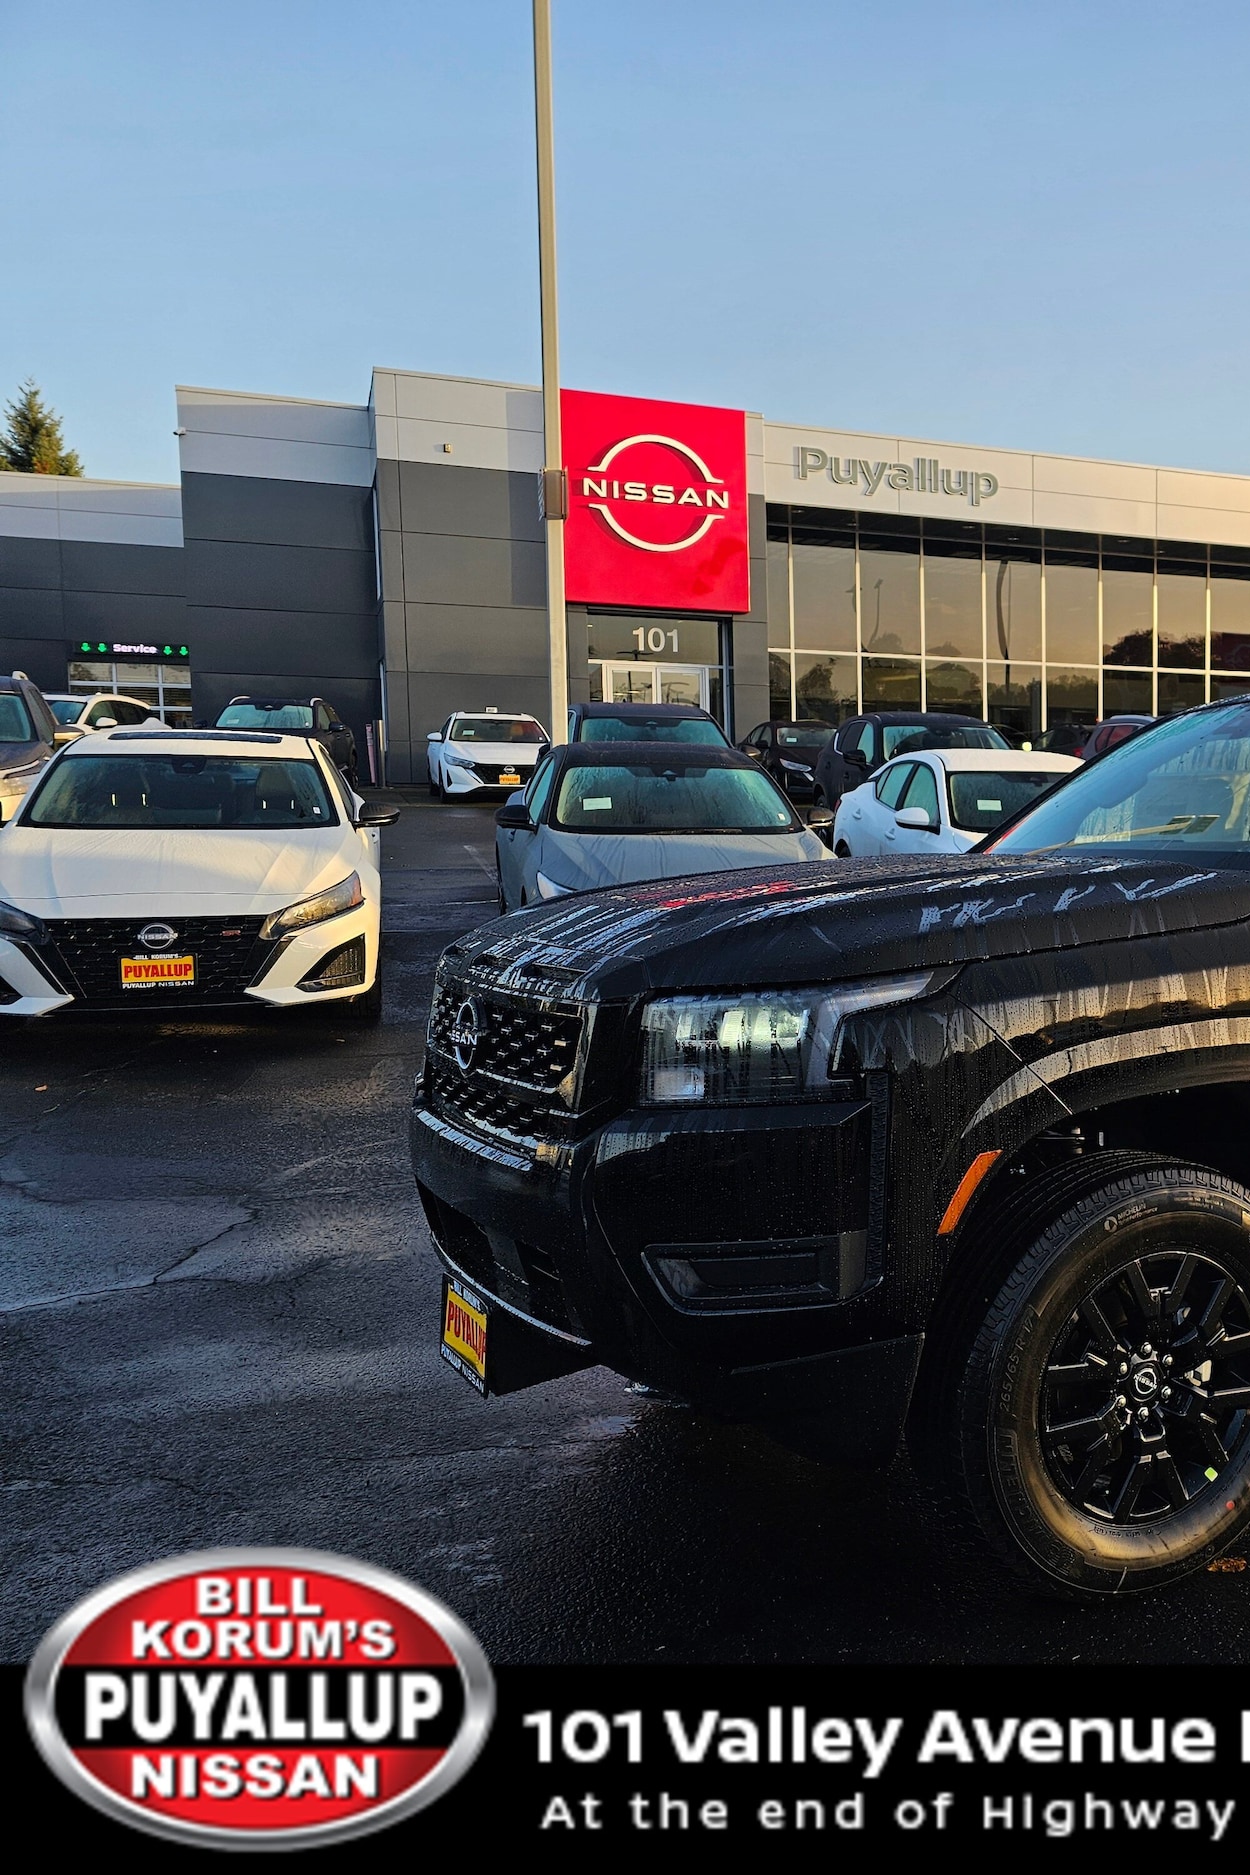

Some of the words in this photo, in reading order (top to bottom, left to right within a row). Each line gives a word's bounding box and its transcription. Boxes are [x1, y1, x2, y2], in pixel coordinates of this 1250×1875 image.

[794, 446, 998, 506] Puyallup
[582, 477, 729, 510] NISSAN
[112, 643, 158, 654] Service
[632, 626, 680, 653] 101
[123, 964, 193, 979] PUYALLUP
[450, 1029, 478, 1046] SSAN
